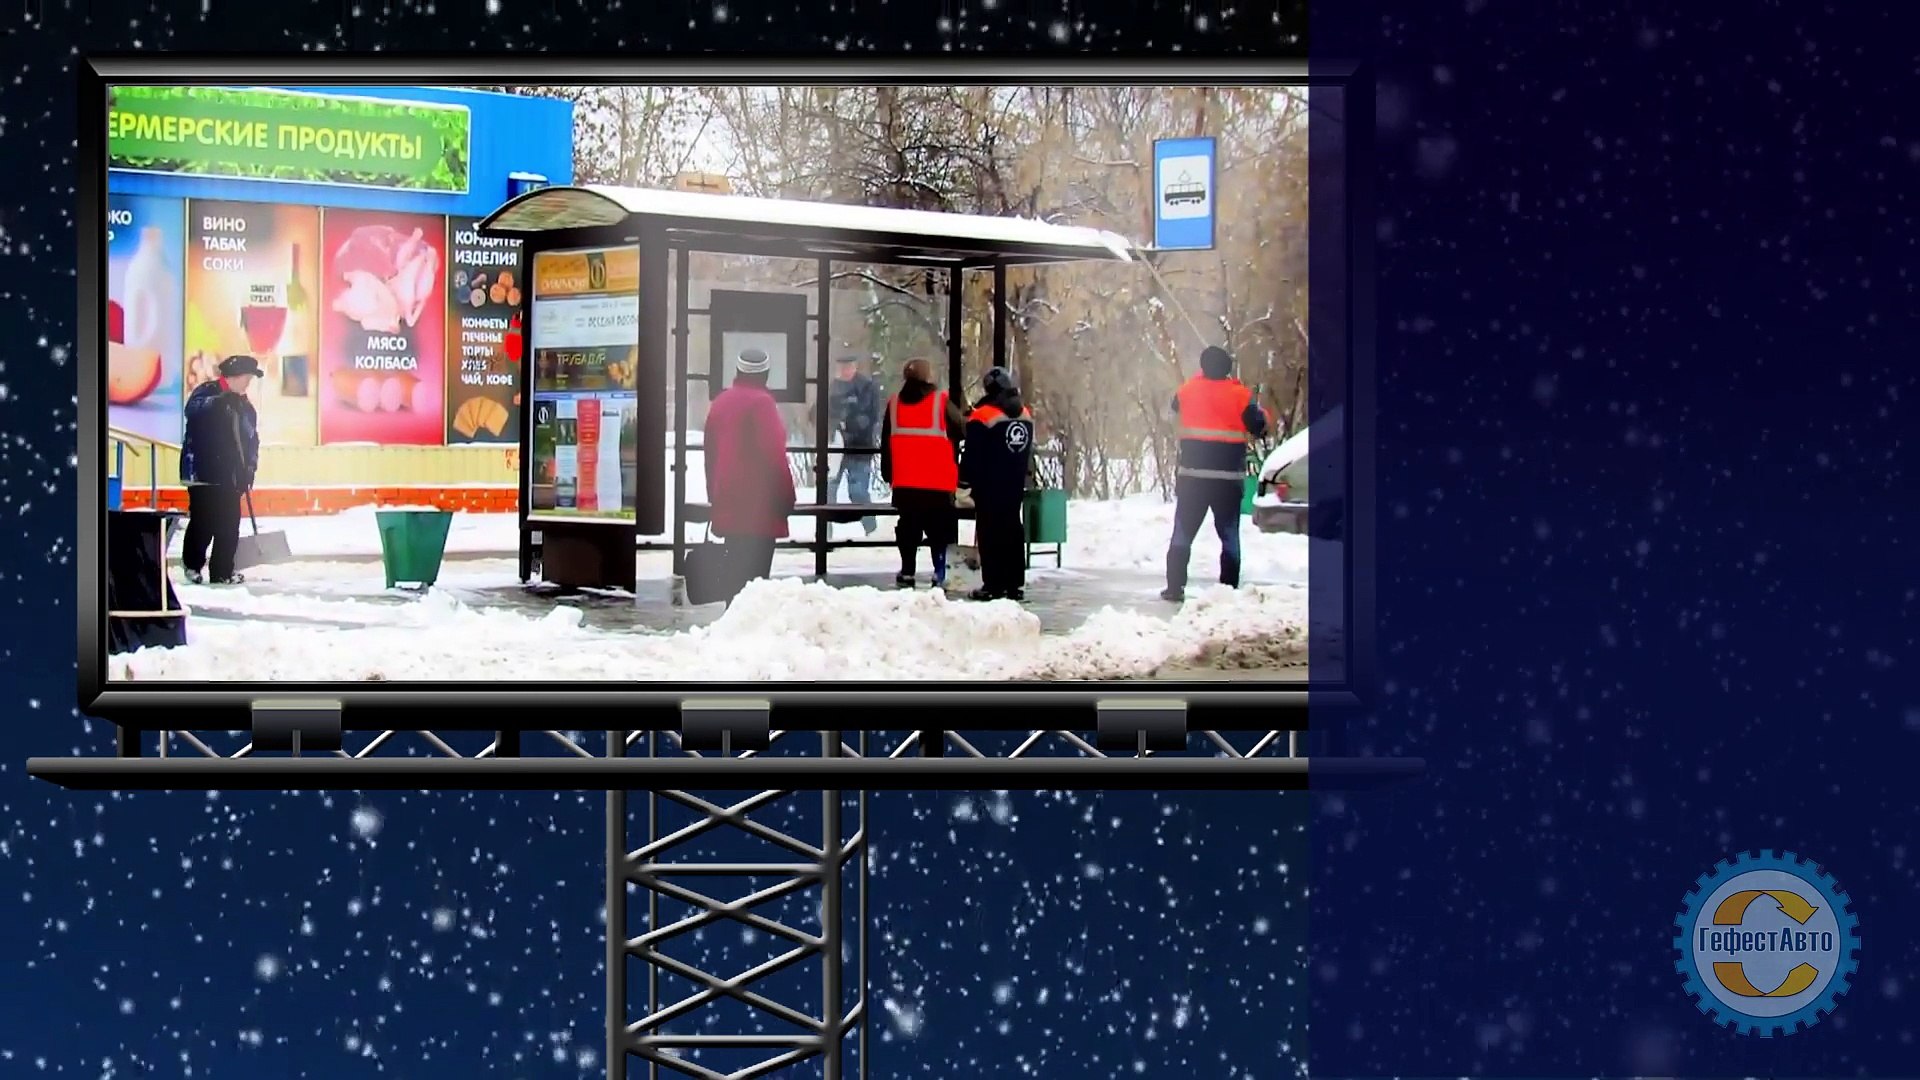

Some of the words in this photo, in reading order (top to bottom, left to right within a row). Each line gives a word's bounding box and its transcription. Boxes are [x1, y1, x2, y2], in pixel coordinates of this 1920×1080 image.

[109, 111, 268, 148] ЕРМЕРСКИЕ
[278, 125, 422, 160] ПРОДУКТЫ
[108, 210, 132, 225] КО
[203, 216, 246, 232] ВИНО
[202, 236, 247, 252] ТАБАК
[203, 257, 244, 271] СОКИ
[455, 250, 517, 267] ИЗДЕЛИЯ
[462, 317, 508, 329] КОНФЕТЫ
[367, 335, 407, 351] МЯСО
[462, 332, 502, 343] ПЕЧЕНЬЕ
[462, 345, 494, 357] ТОРТЫ
[355, 355, 418, 370] КОЛБАСА
[461, 374, 484, 386] ЧАЙ,
[486, 374, 513, 386] КОФЕ
